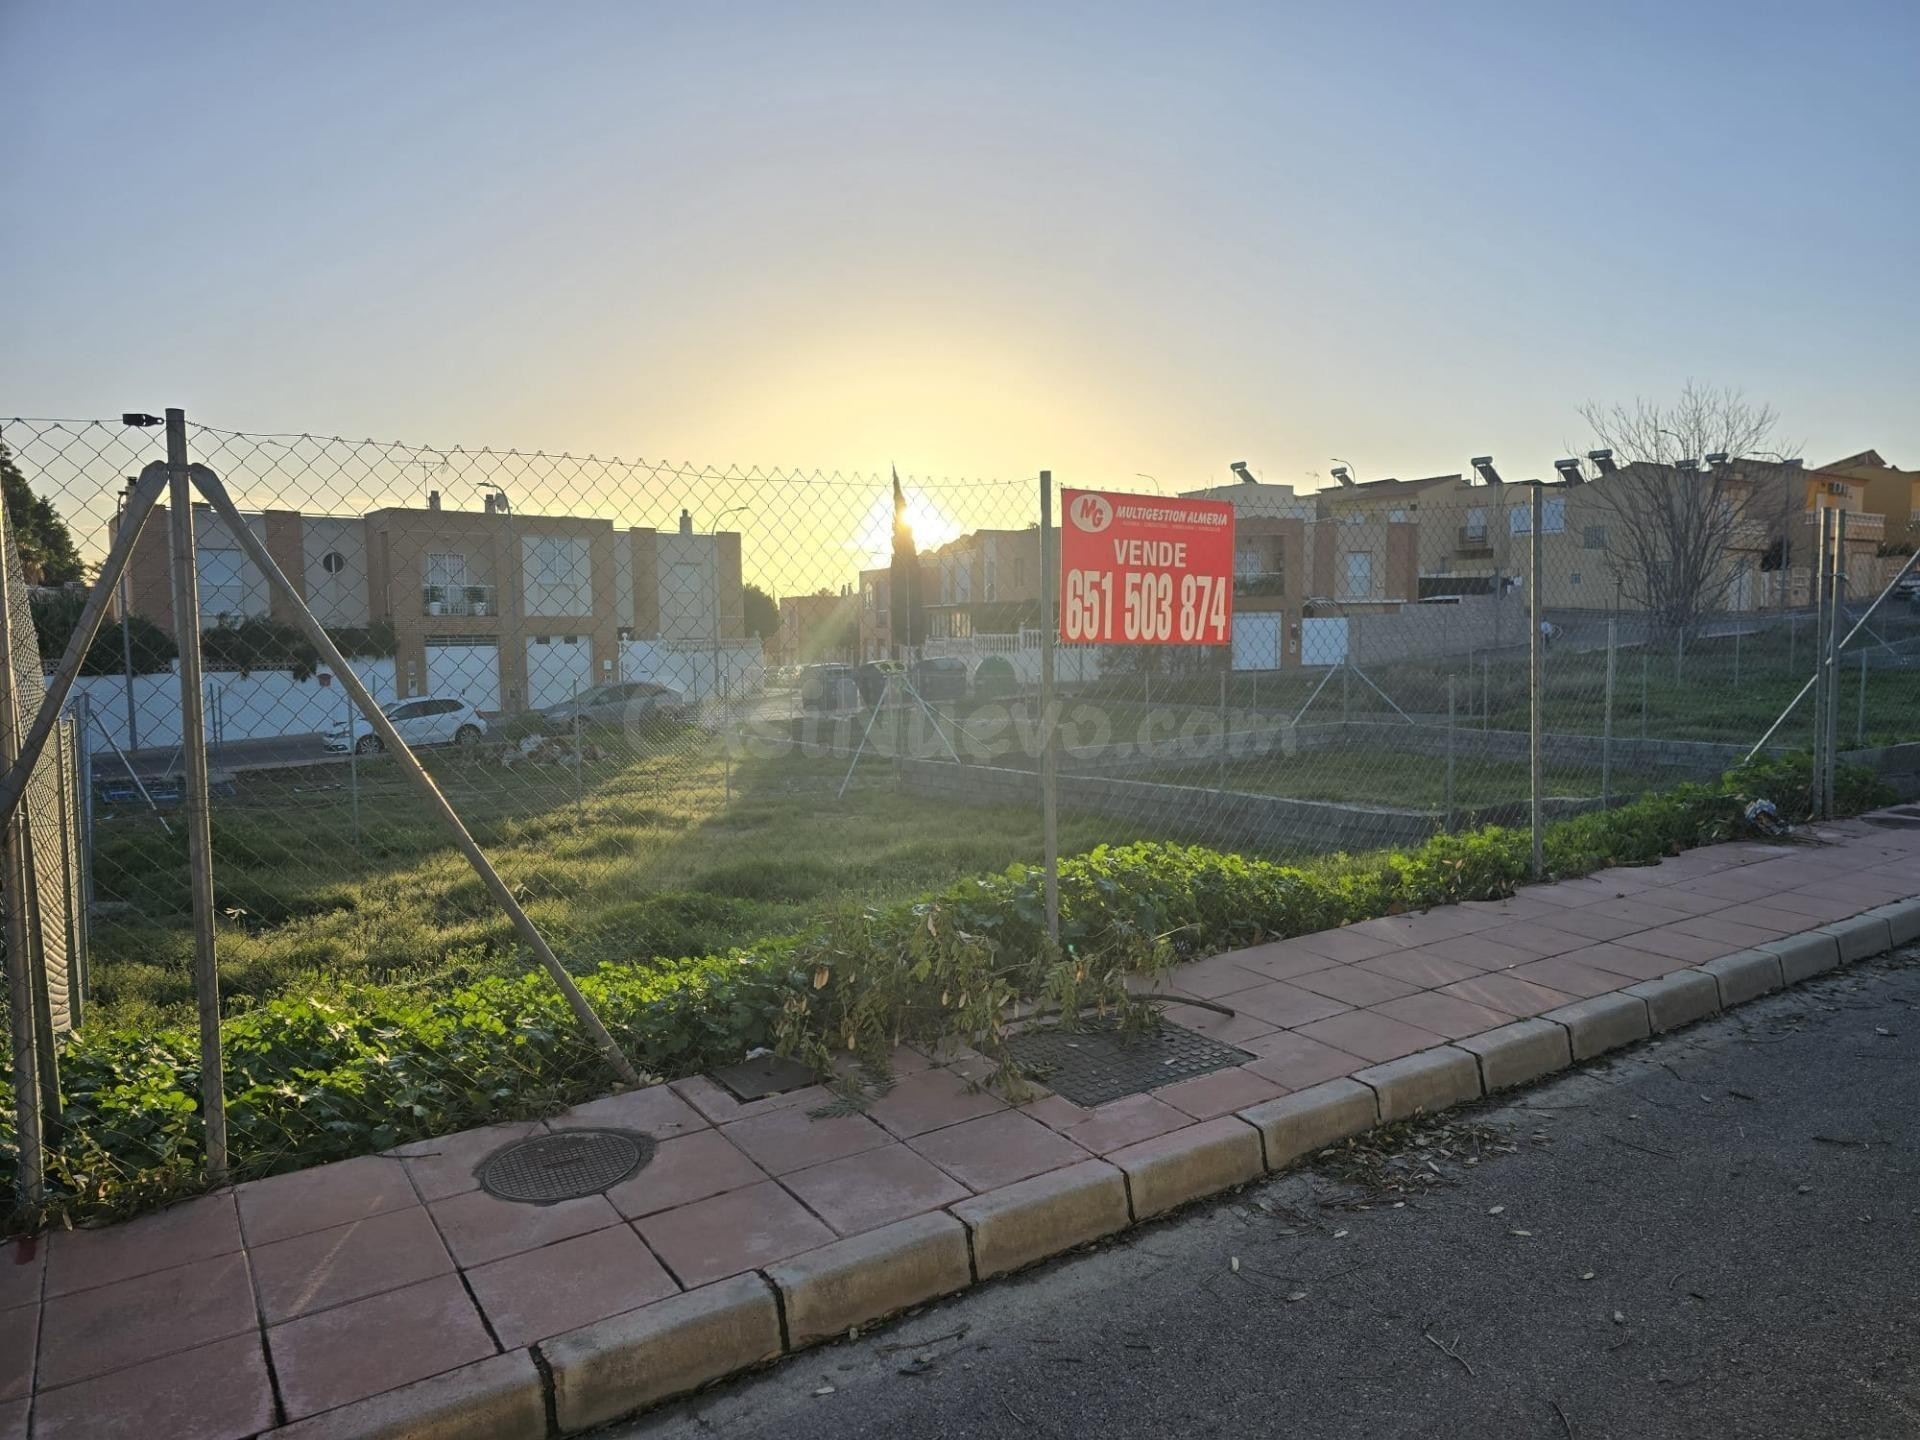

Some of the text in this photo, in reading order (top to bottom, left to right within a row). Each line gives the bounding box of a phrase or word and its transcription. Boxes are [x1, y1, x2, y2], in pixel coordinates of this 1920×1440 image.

[1080, 499, 1104, 528] MG
[1116, 506, 1228, 526] MULTIGESTION ALMERIA
[1114, 539, 1187, 567] VENDE
[1067, 569, 1226, 641] 651 503 874
